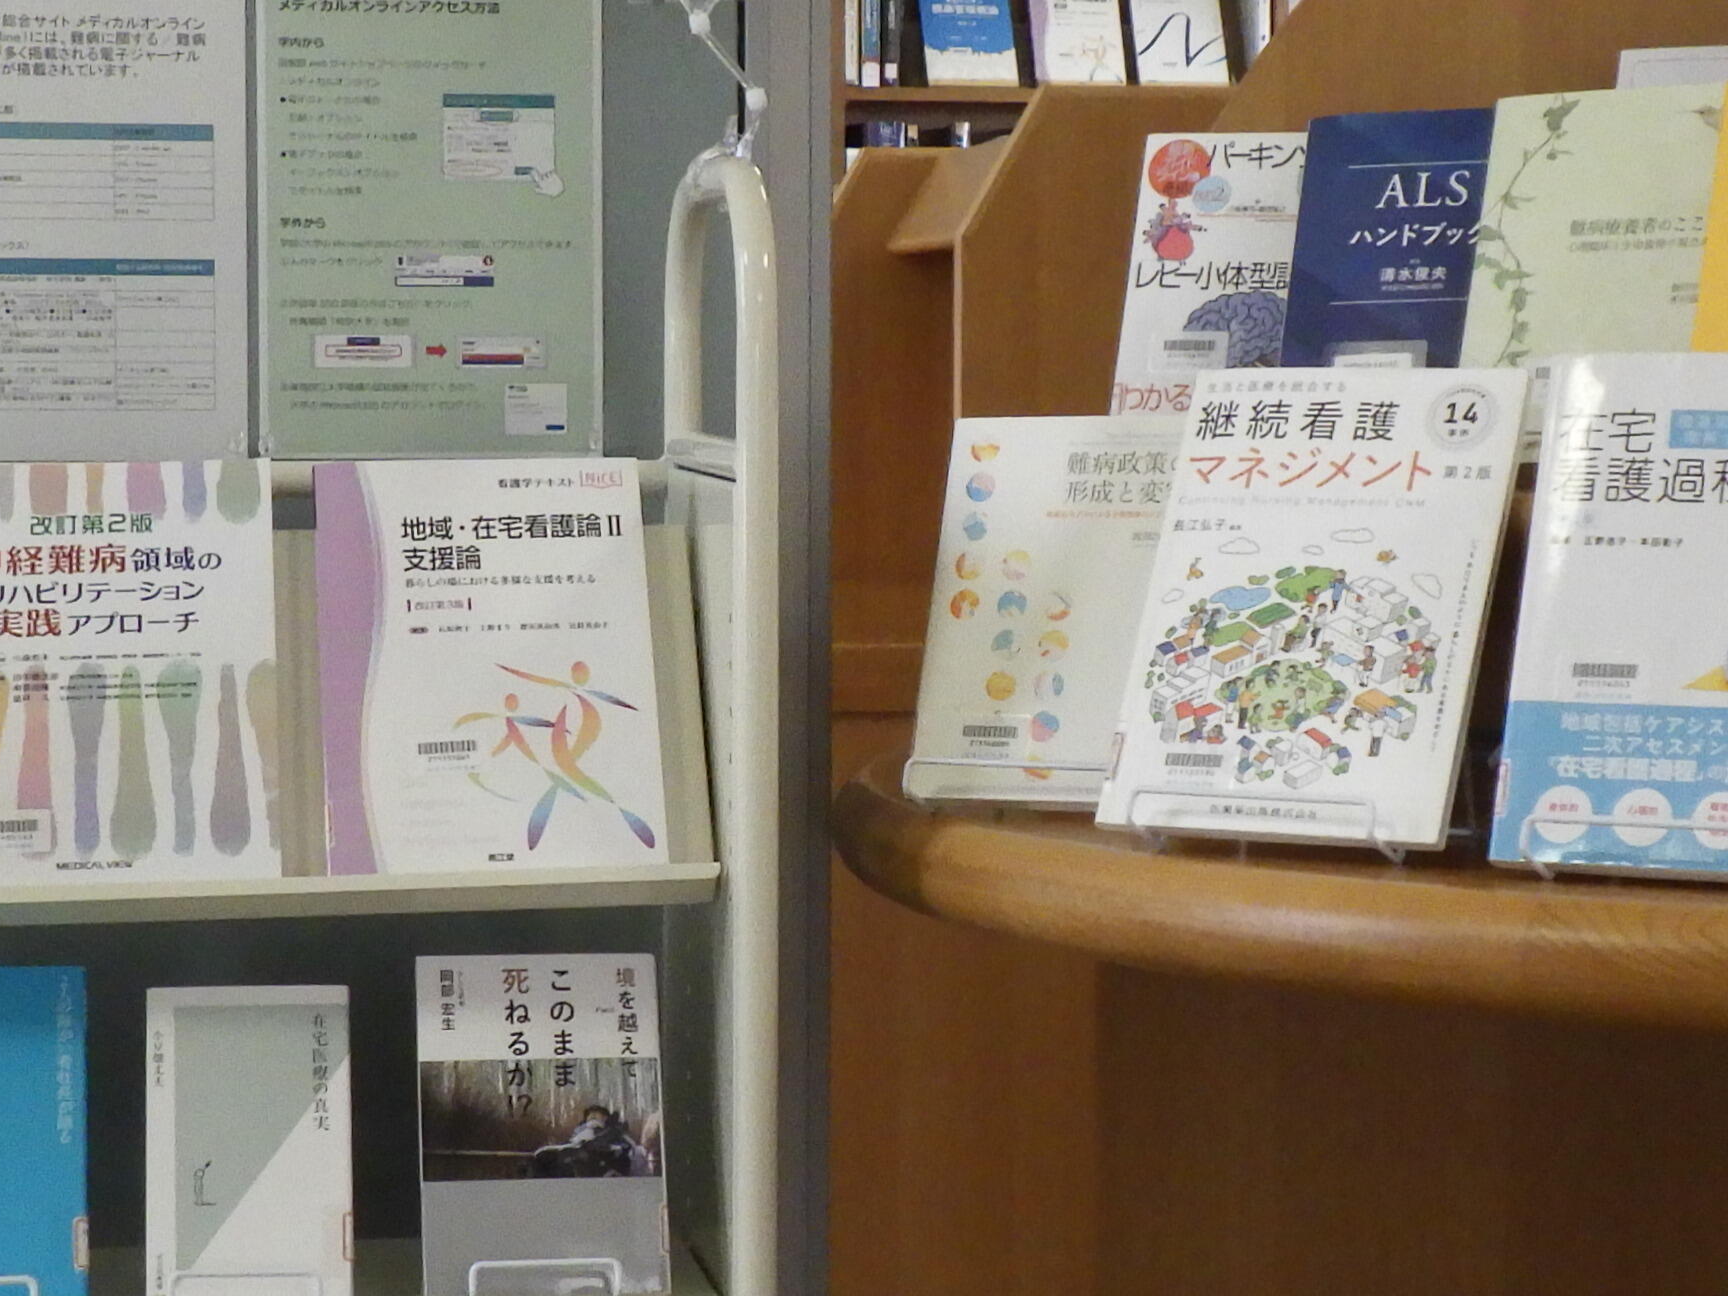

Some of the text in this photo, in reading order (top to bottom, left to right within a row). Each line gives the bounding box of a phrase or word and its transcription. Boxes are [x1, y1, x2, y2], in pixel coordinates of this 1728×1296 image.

[1206, 141, 1306, 171] パーキン
[1375, 170, 1471, 210] ALS
[1195, 399, 1400, 441] 継続看護
[1443, 402, 1479, 425] 14
[1559, 407, 1657, 454] 在宅
[1189, 447, 1433, 492] マネジメント
[1442, 464, 1493, 481] 第2版
[1067, 479, 1173, 505] 形成と変
[29, 512, 154, 537] 改訂第2版
[401, 545, 482, 573] 支援論
[56, 861, 104, 872] MEDICAL
[549, 968, 577, 1088] このまま
[615, 966, 640, 1079] 境を越えて
[311, 1011, 331, 1133] 在宅医療の真実
